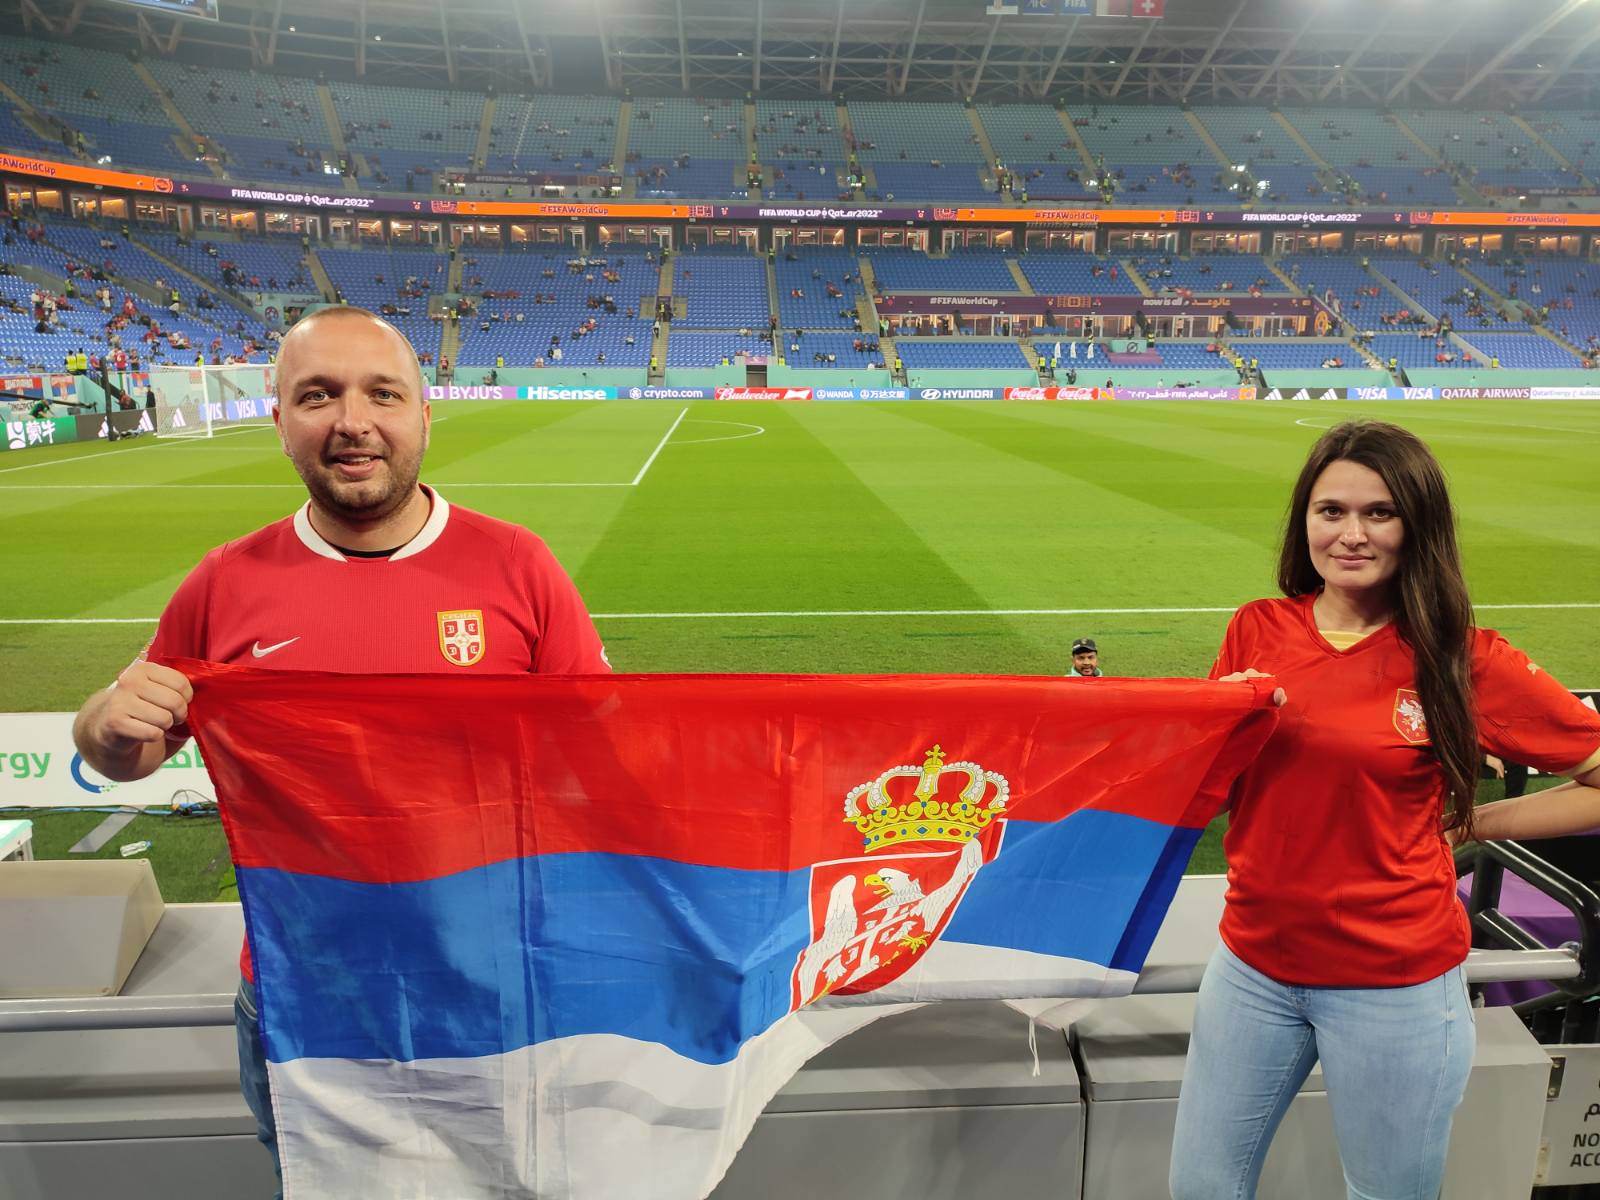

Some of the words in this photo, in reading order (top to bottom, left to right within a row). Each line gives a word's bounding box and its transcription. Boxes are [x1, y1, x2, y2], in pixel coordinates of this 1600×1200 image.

[231, 189, 251, 198] FIFA
[251, 191, 285, 201] WORLD
[286, 194, 304, 202] CUP
[540, 206, 608, 214] #FIFAWorldCup
[759, 209, 777, 217] FIFA
[777, 209, 806, 217] WORLD
[806, 209, 822, 217] CUP
[1035, 212, 1099, 220] #FIFAWorldCup
[1242, 213, 1260, 221] FIFA
[1260, 213, 1287, 221] WORLD
[1287, 213, 1303, 221] CUP
[929, 297, 998, 306] #FIFAWorldCup
[1171, 297, 1183, 306] all
[449, 386, 503, 399] BYJU'S
[527, 386, 607, 400] Hisense
[644, 388, 703, 399] crypto.com
[717, 387, 780, 400] Budweiser
[943, 389, 993, 399] HYUNDAI
[1354, 387, 1388, 400] VISA
[1401, 387, 1433, 400] VISA
[1441, 388, 1479, 399] QATAR
[1483, 388, 1530, 399] AIRWAYS
[235, 399, 257, 418] VISA
